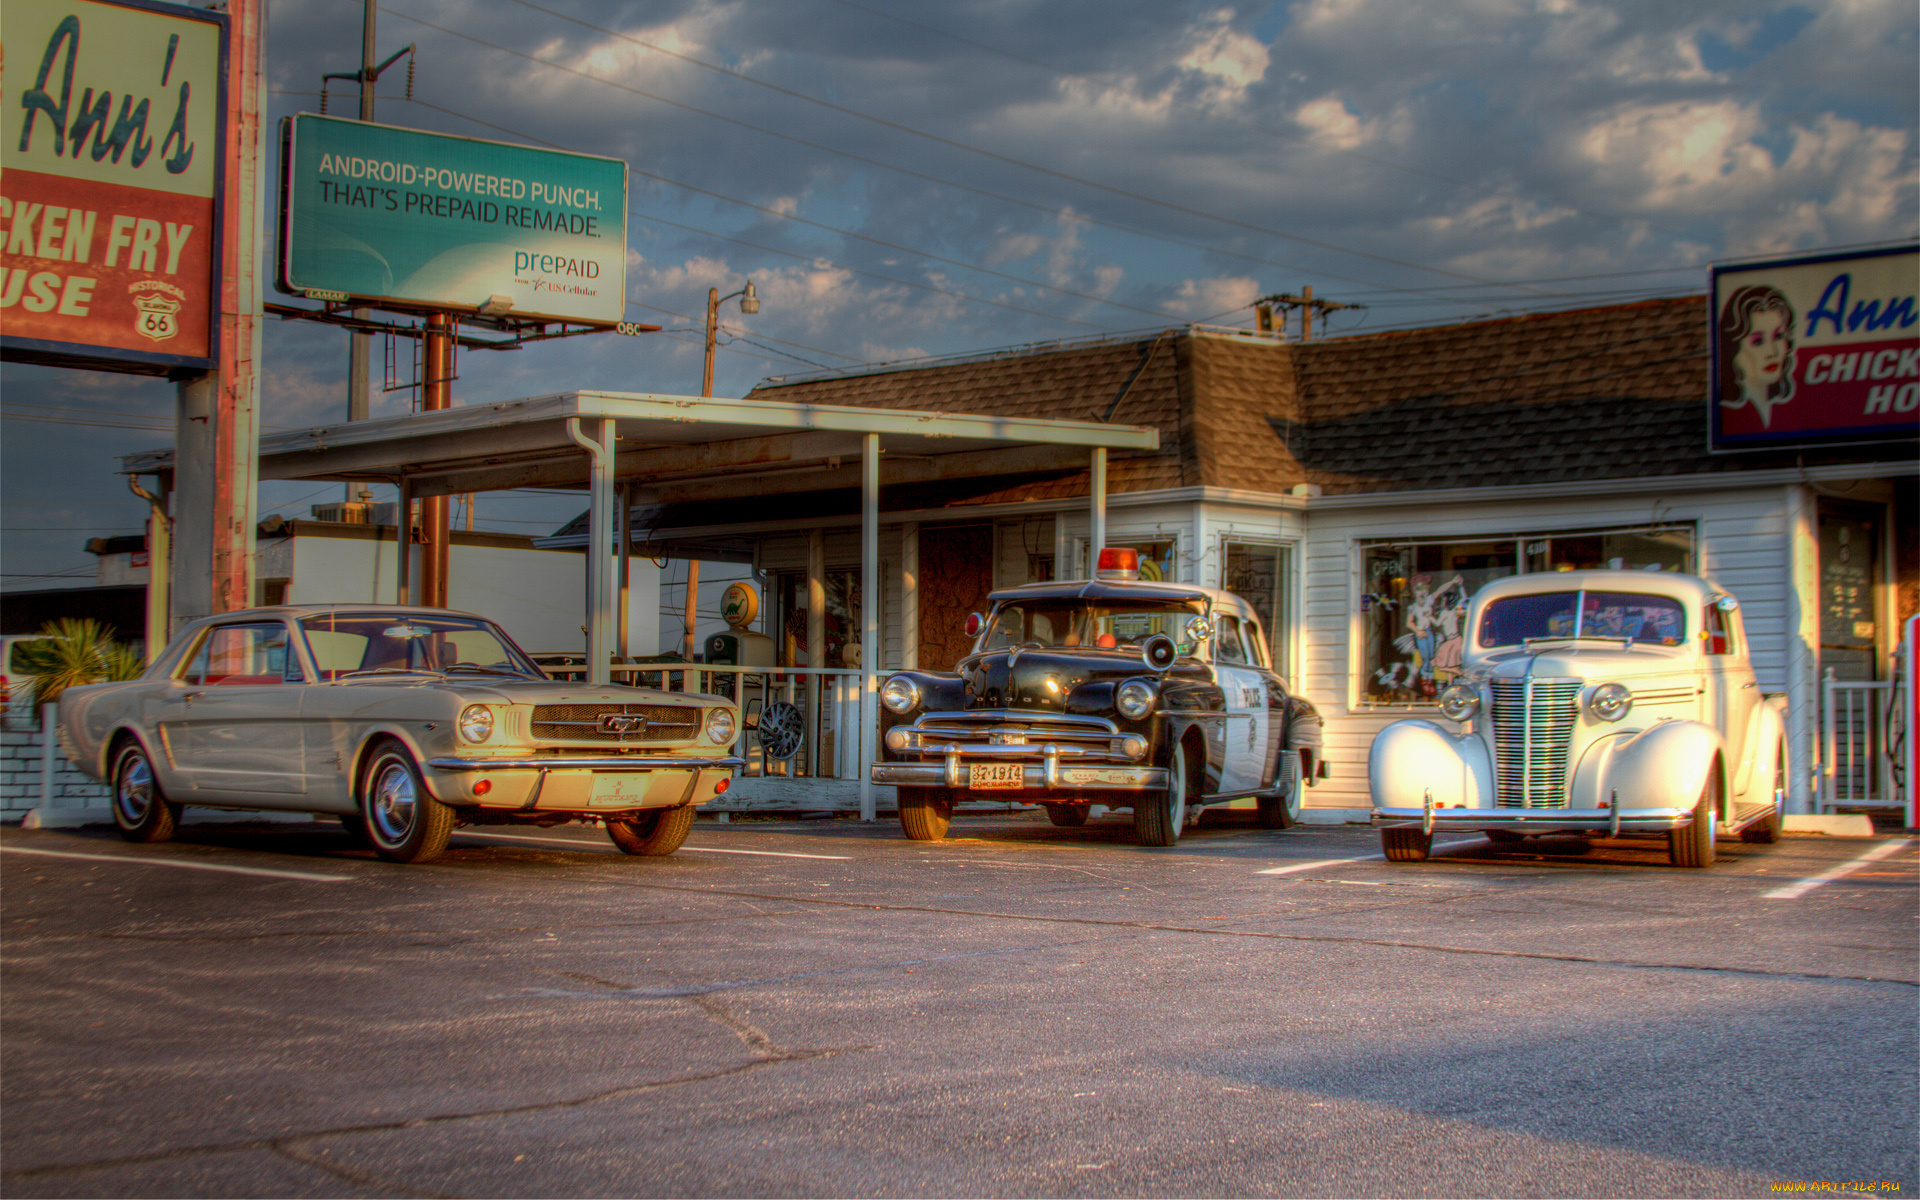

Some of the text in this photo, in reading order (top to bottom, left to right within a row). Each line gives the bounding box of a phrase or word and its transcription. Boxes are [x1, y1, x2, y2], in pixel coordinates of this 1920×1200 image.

[18, 14, 195, 175] Ann's
[319, 180, 602, 238] THAT'S PREPAID REMADE.
[531, 181, 602, 212] PUNCH.
[104, 214, 194, 275] FRY
[128, 280, 187, 301] HISTORICAL
[308, 290, 347, 300] LAMAR
[562, 284, 597, 296] Cellular
[1805, 273, 1920, 338] Ann
[146, 313, 168, 332] 66
[1804, 348, 1920, 386] CHICK
[1863, 381, 1920, 415] HO
